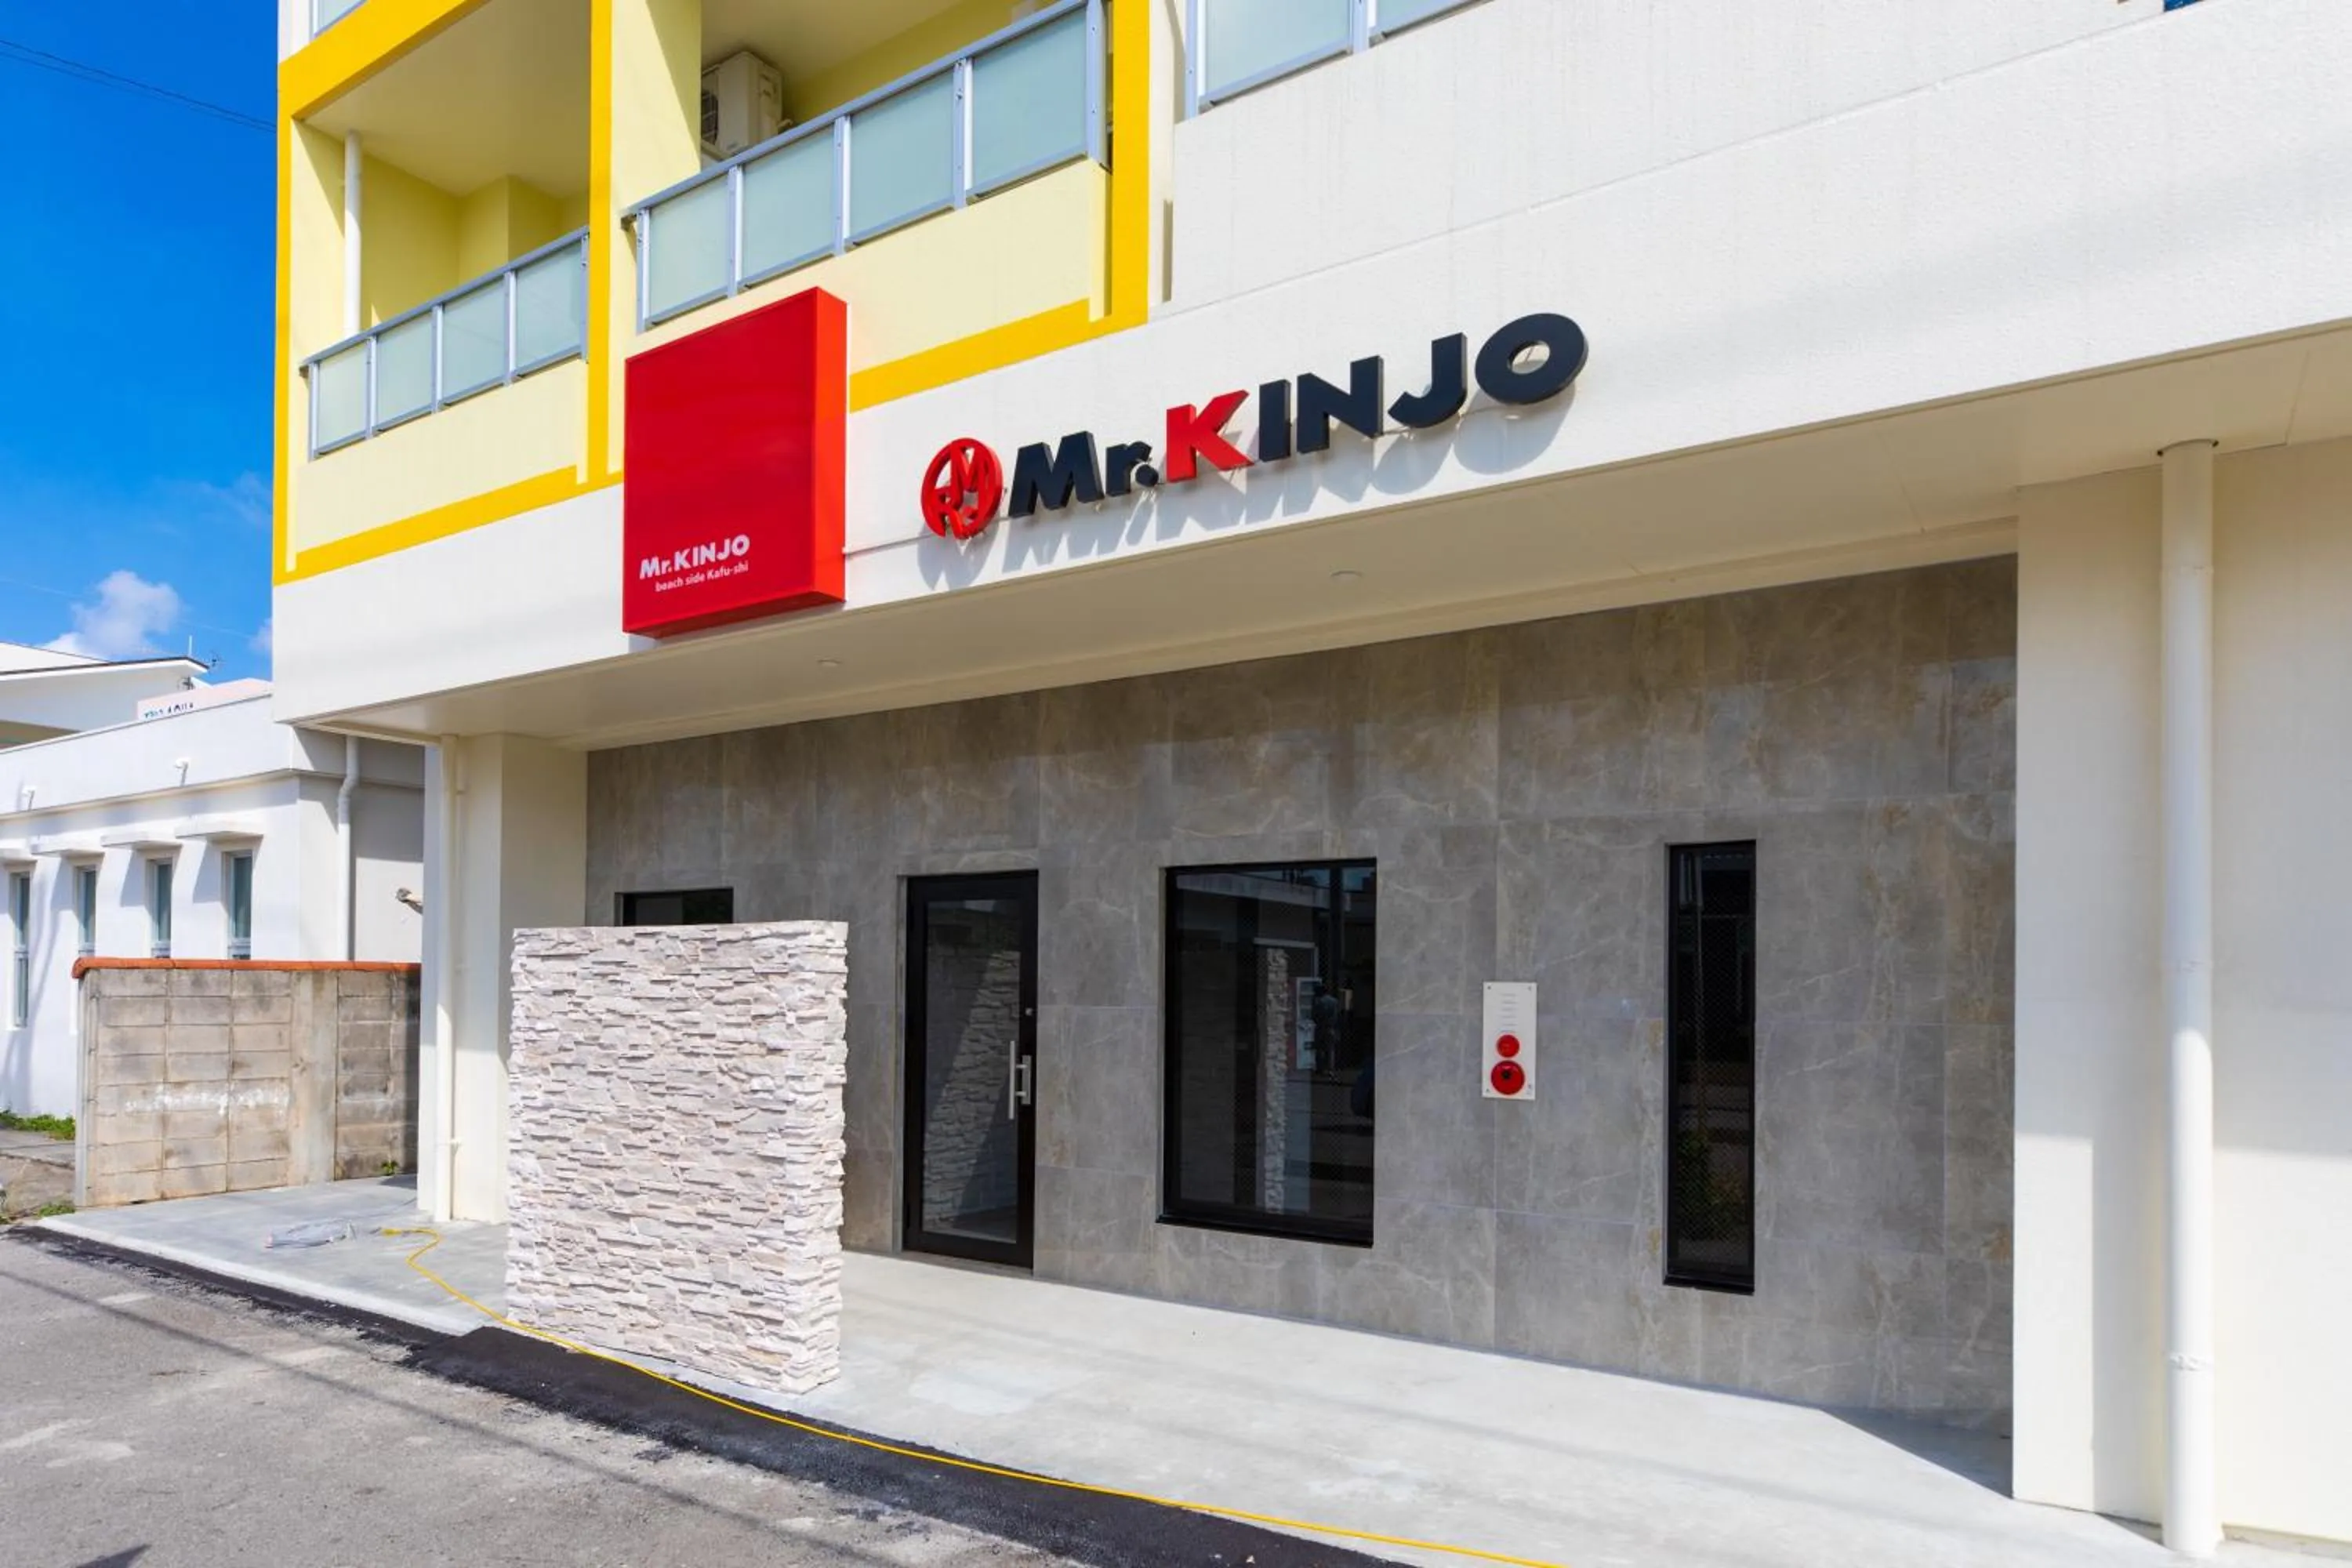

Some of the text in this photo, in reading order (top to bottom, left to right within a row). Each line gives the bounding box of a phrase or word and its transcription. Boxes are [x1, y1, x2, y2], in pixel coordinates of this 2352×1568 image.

[1009, 313, 1588, 517] Mr.KINJO
[639, 534, 750, 580] Mr.KINJO
[655, 577, 684, 592] beach
[685, 572, 705, 586] side
